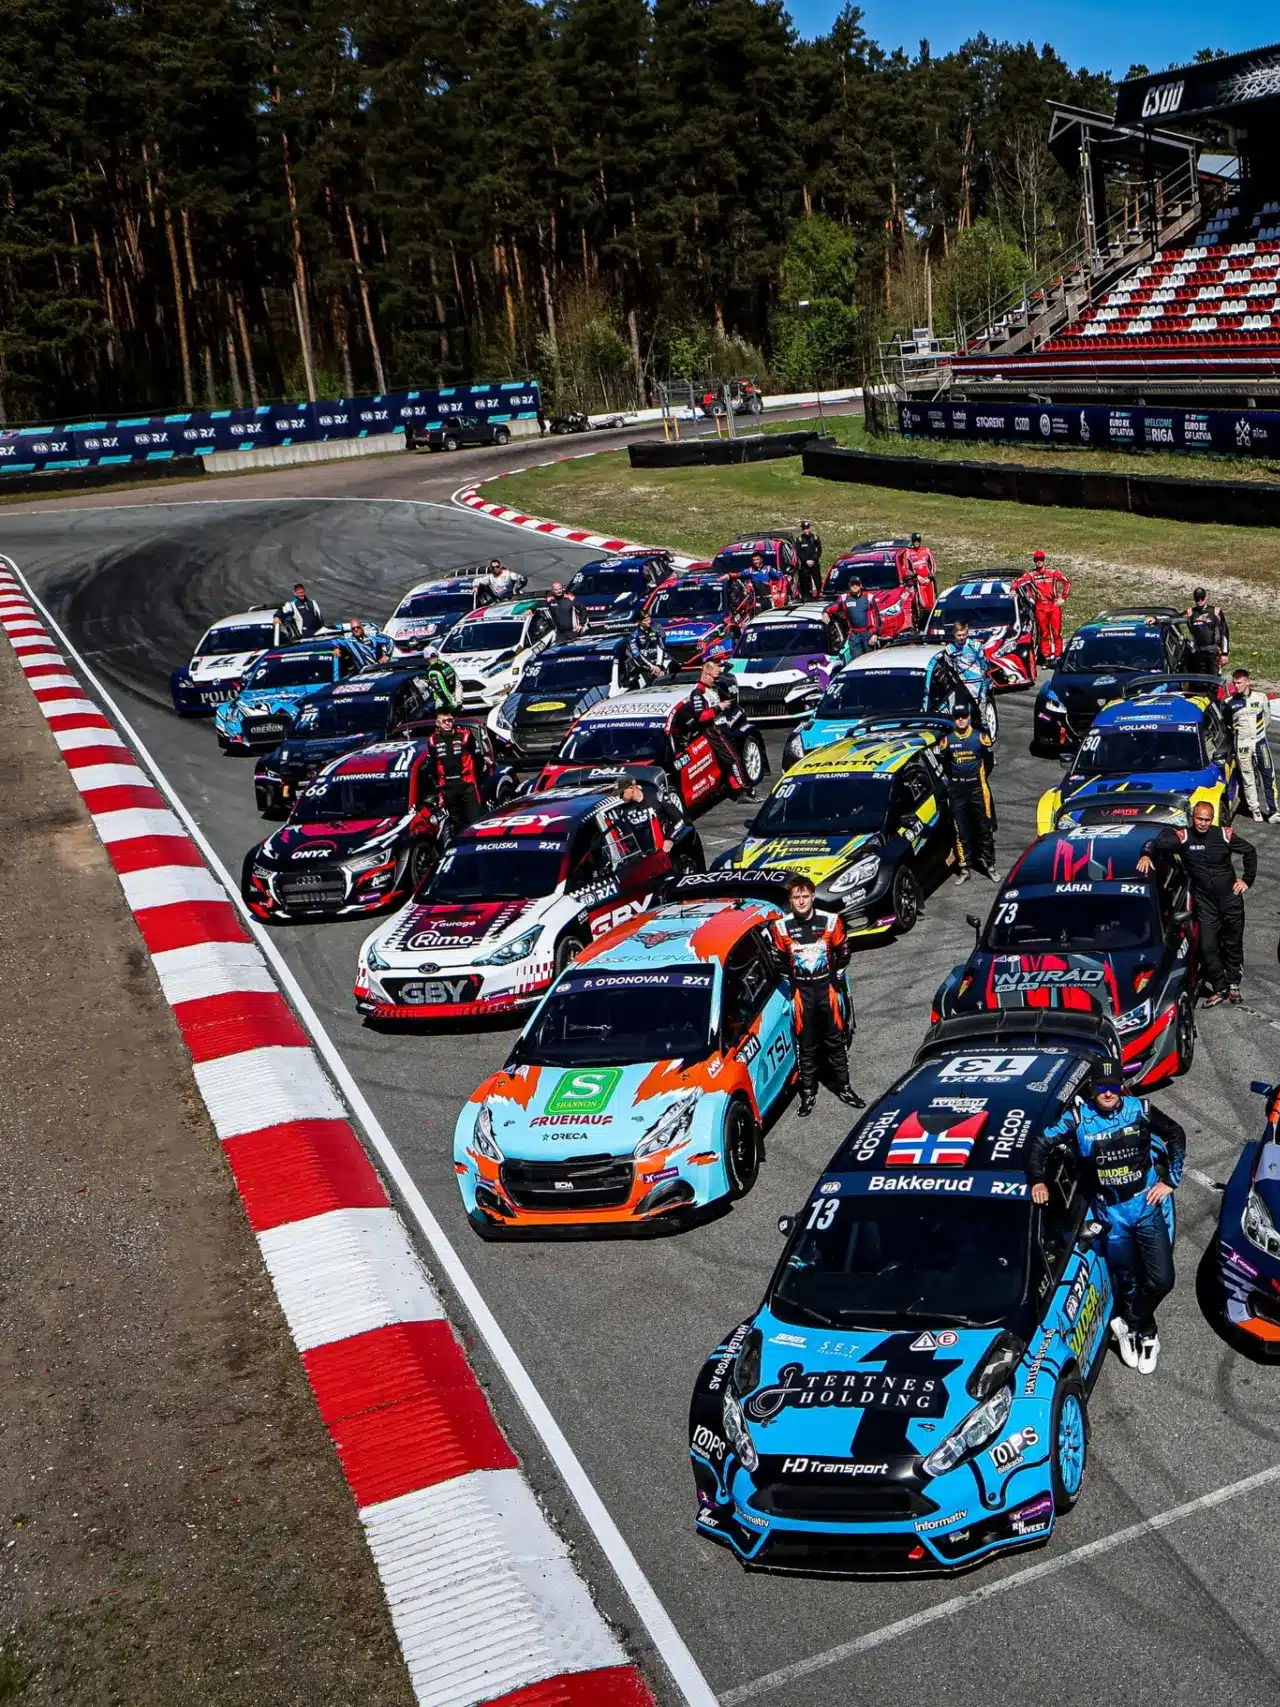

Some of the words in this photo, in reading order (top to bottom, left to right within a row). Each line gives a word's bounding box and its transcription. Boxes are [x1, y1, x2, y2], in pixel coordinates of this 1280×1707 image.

[1141, 80, 1185, 118] CSDD
[291, 419, 305, 428] RX
[334, 414, 349, 424] RX
[976, 416, 1005, 429] STORENT
[1109, 419, 1122, 427] EURO
[1144, 418, 1173, 427] WELCOME
[1184, 421, 1198, 430] EURO
[152, 432, 168, 443] RX
[200, 428, 216, 438] RX
[1151, 429, 1174, 442] RIGA
[51, 442, 68, 452] RX
[102, 437, 119, 448] RX
[659, 593, 669, 601] 10
[745, 634, 757, 643] 55
[1069, 639, 1085, 651] 23
[250, 724, 284, 734] OBERON
[1178, 725, 1197, 733] RX1
[1082, 736, 1101, 751] 30
[803, 759, 886, 770] MARTIN
[589, 767, 627, 776] DELL
[305, 784, 329, 797] 66
[775, 784, 797, 799] 60
[471, 815, 572, 829] GBY
[475, 842, 518, 851] BACIUSKA
[538, 841, 561, 850] RX1
[291, 849, 332, 860] ONYX
[435, 856, 454, 874] 14
[716, 870, 787, 882] RACING
[1055, 883, 1093, 893] KÁRAI
[1120, 884, 1146, 894] RX1
[994, 902, 1019, 925] 73
[407, 930, 474, 950] Rimo
[583, 978, 595, 988] P.
[596, 975, 670, 987] O'DONOVAN
[682, 975, 711, 987] RX1
[996, 967, 1105, 984] NYIRÁD
[401, 980, 469, 1004] GBY
[766, 1037, 793, 1071] TSL
[953, 1057, 1017, 1073] 13
[562, 1073, 604, 1099] S
[555, 1100, 598, 1110] SHANNON
[551, 1132, 589, 1141] ORECA
[856, 1108, 900, 1162] TRICOD
[991, 1107, 1026, 1161] TRICOD
[868, 1175, 974, 1192] Bakkerud
[991, 1181, 1028, 1196] RX1
[805, 1198, 840, 1230] 13
[709, 1377, 721, 1390] AS
[805, 1374, 936, 1394] TERTNES
[799, 1390, 931, 1409] HOLDING
[782, 1457, 809, 1474] HD
[810, 1460, 889, 1477] Transport
[914, 1509, 968, 1532] Informativ
